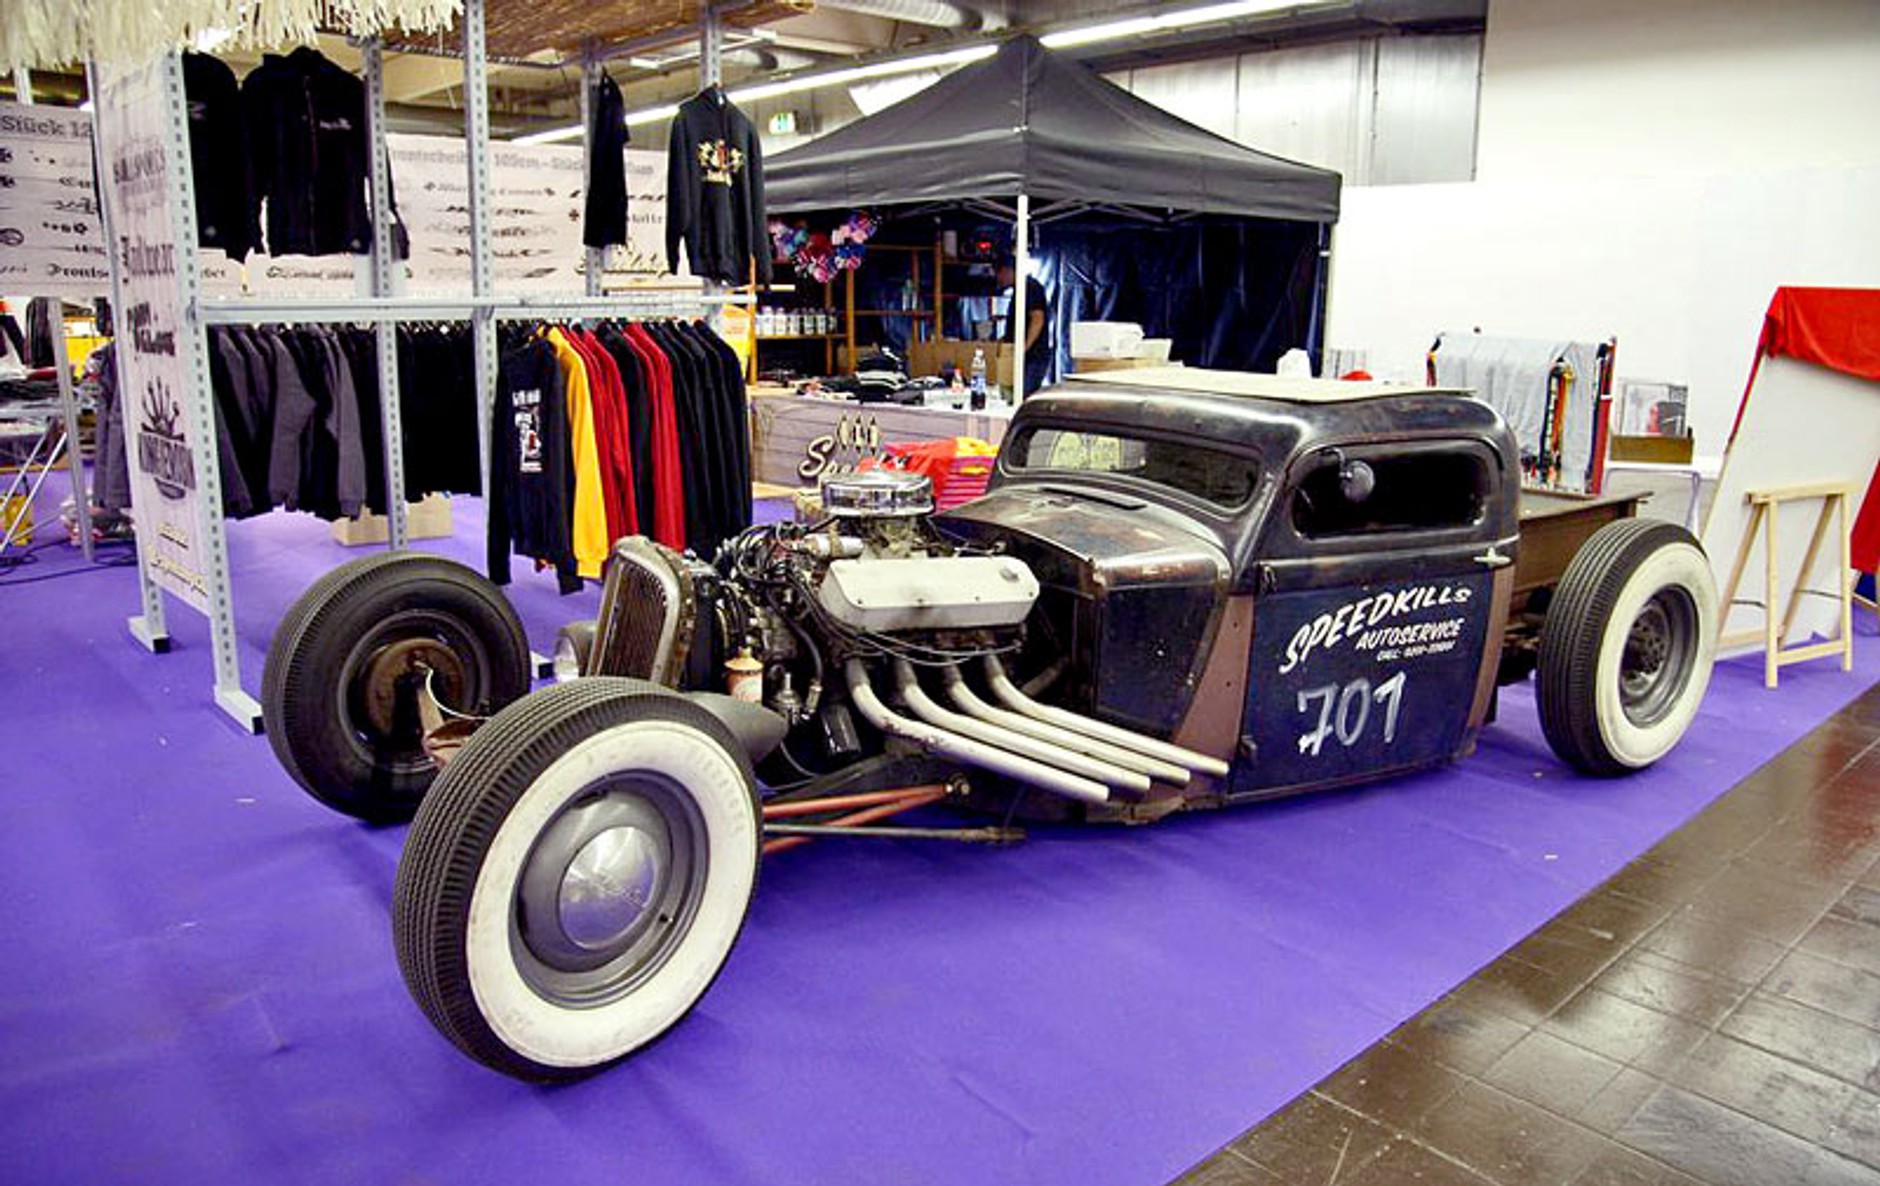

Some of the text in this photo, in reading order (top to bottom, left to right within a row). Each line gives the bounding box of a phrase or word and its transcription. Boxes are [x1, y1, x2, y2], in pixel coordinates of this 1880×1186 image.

[1278, 586, 1473, 675] SPEEDKILLS
[1355, 617, 1465, 650] AUTOSERVICE
[1297, 671, 1407, 756] 701
